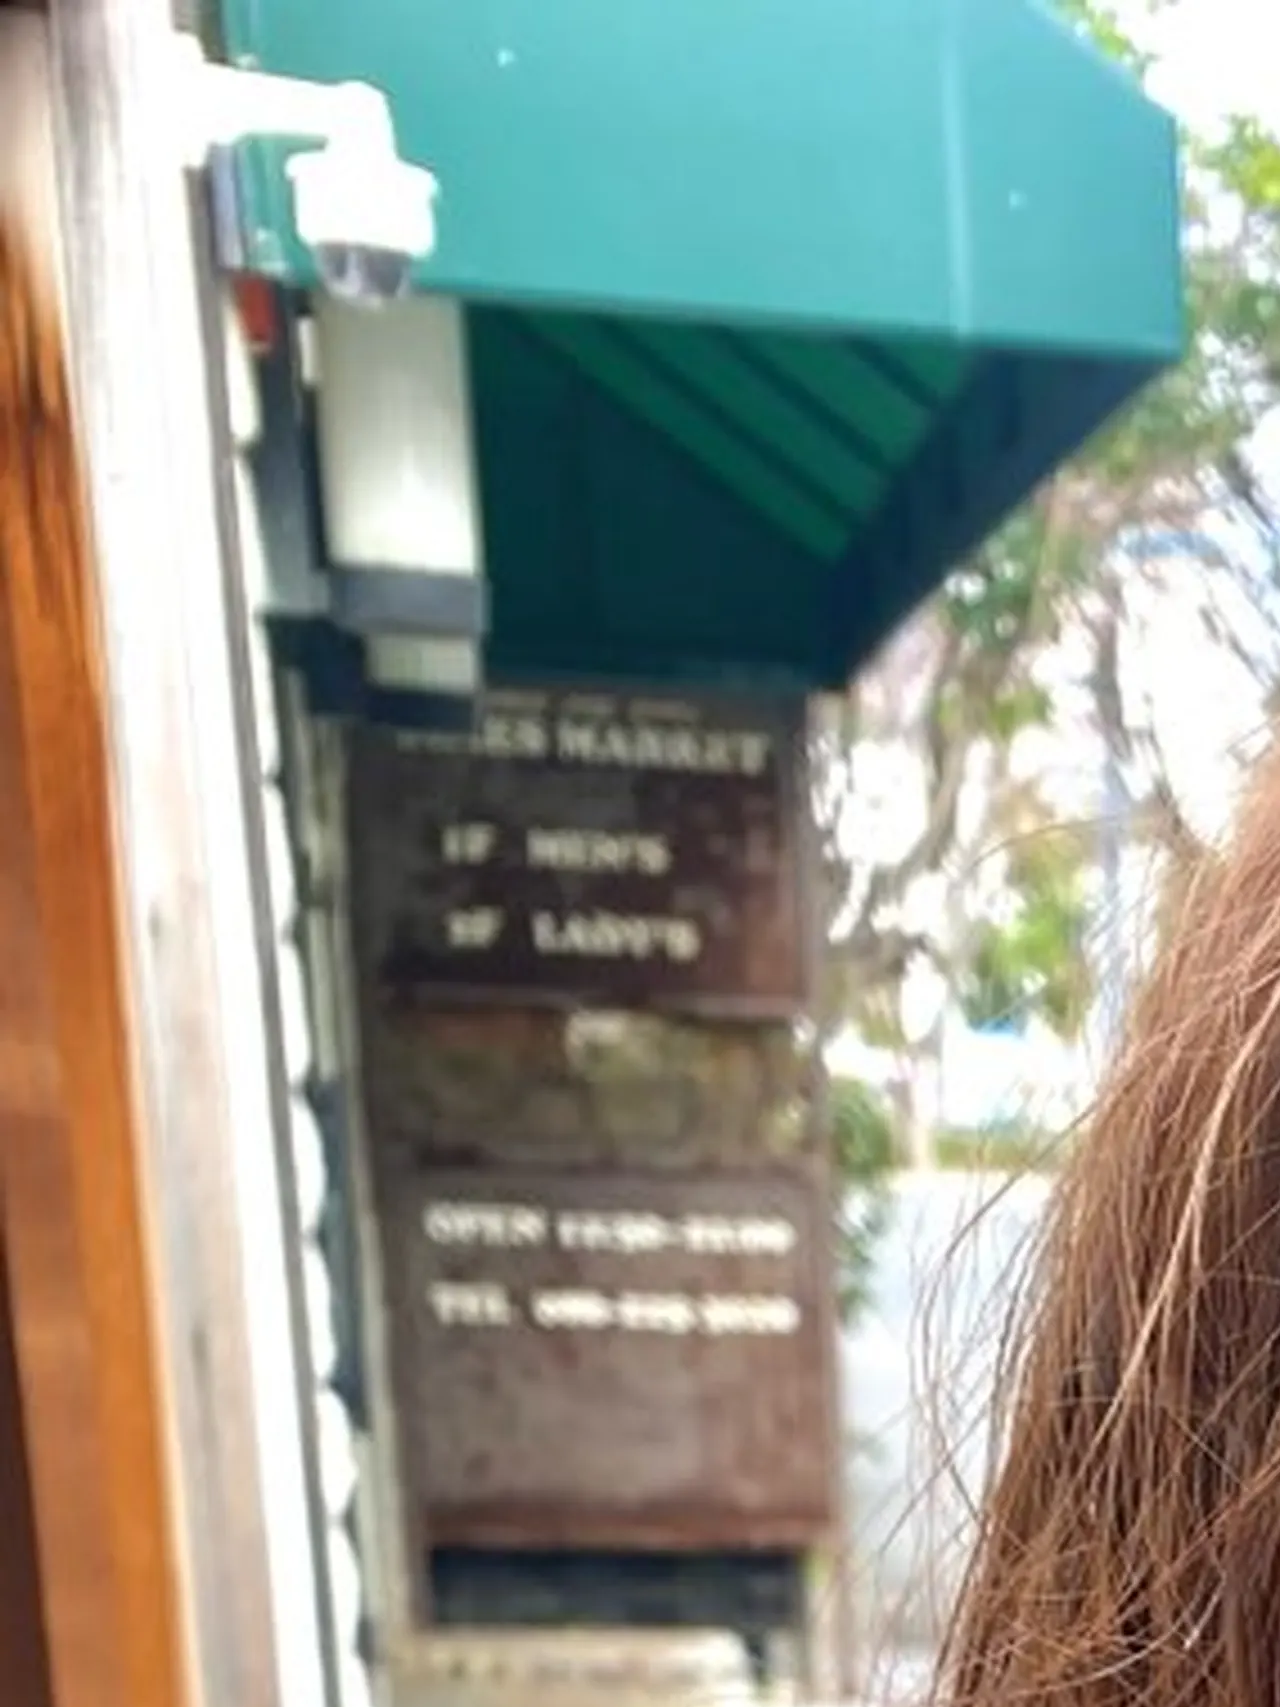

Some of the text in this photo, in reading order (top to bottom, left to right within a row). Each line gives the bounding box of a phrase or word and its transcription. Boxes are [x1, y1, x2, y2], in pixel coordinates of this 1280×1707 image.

[558, 720, 772, 776] MARKET
[423, 1201, 548, 1248] OPEN
[428, 1281, 513, 1327] TEL
